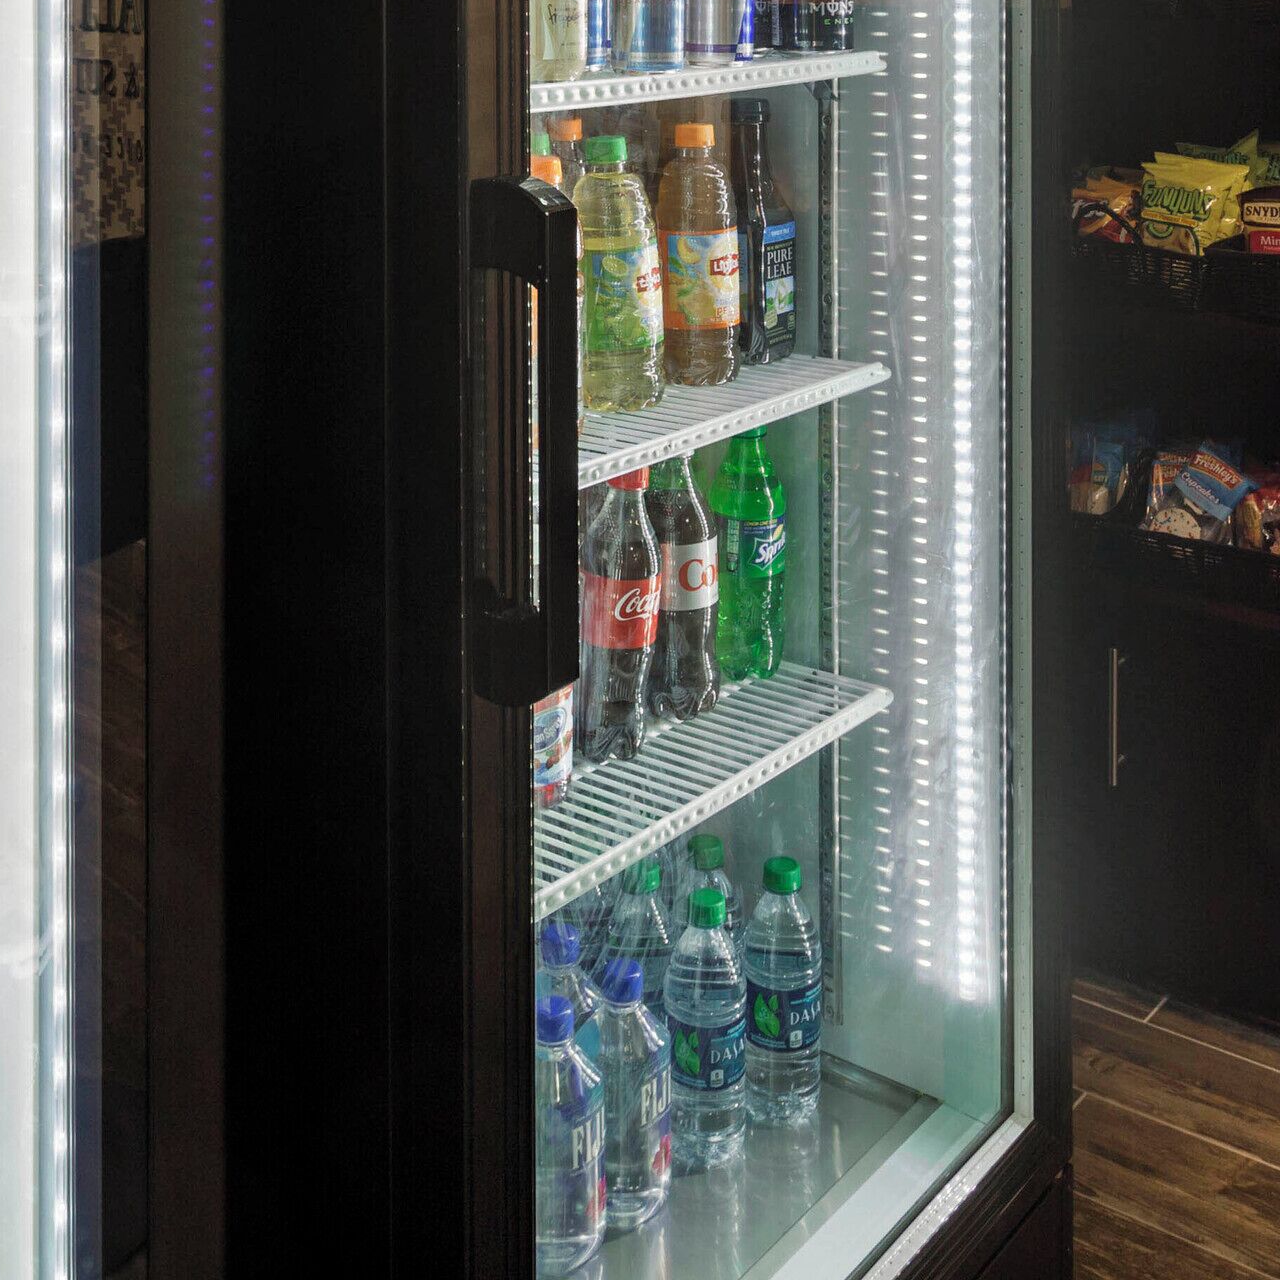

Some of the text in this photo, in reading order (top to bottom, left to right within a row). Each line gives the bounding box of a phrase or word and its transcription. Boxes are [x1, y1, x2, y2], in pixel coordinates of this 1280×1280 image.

[767, 246, 793, 265] PURE
[767, 264, 792, 280] LEAF
[571, 1108, 606, 1170] FIJI
